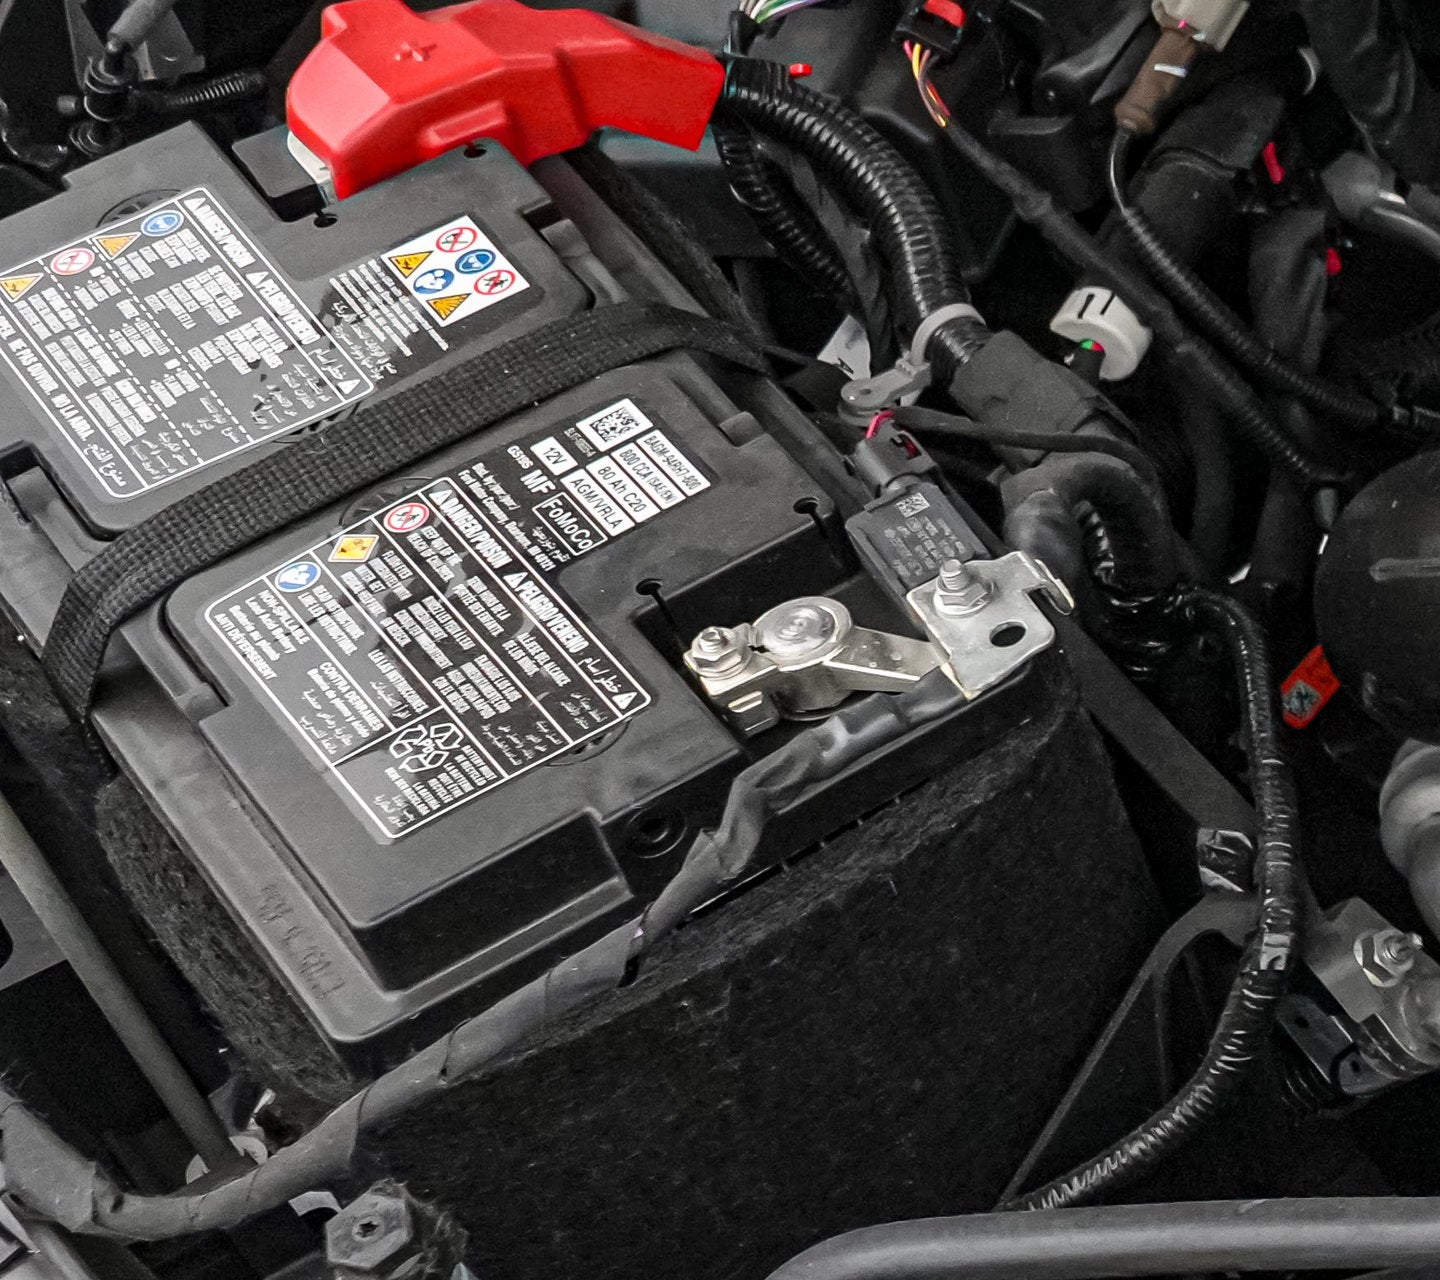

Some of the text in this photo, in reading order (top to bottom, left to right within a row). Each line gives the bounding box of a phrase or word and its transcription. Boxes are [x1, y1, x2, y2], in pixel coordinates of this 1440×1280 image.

[13, 348, 40, 366] PAS
[48, 393, 74, 409] NO
[57, 404, 81, 419] LA
[540, 446, 567, 466] 12V
[618, 448, 641, 465] 800
[631, 461, 655, 480] CCA
[518, 468, 557, 498] MF
[596, 465, 647, 513] 80 Ah C20
[569, 475, 624, 529] AGM/VRLA
[540, 497, 598, 551] FoMoCo
[436, 496, 515, 570] DANGER/POISON
[511, 579, 592, 654] PELIGRO/VENENO
[213, 611, 236, 631] ANTI
[257, 588, 311, 645] NON-SPILLABLE
[257, 611, 279, 631] Acid
[317, 660, 385, 733] CONTRA DERRAMES
[415, 738, 437, 755] Pb
